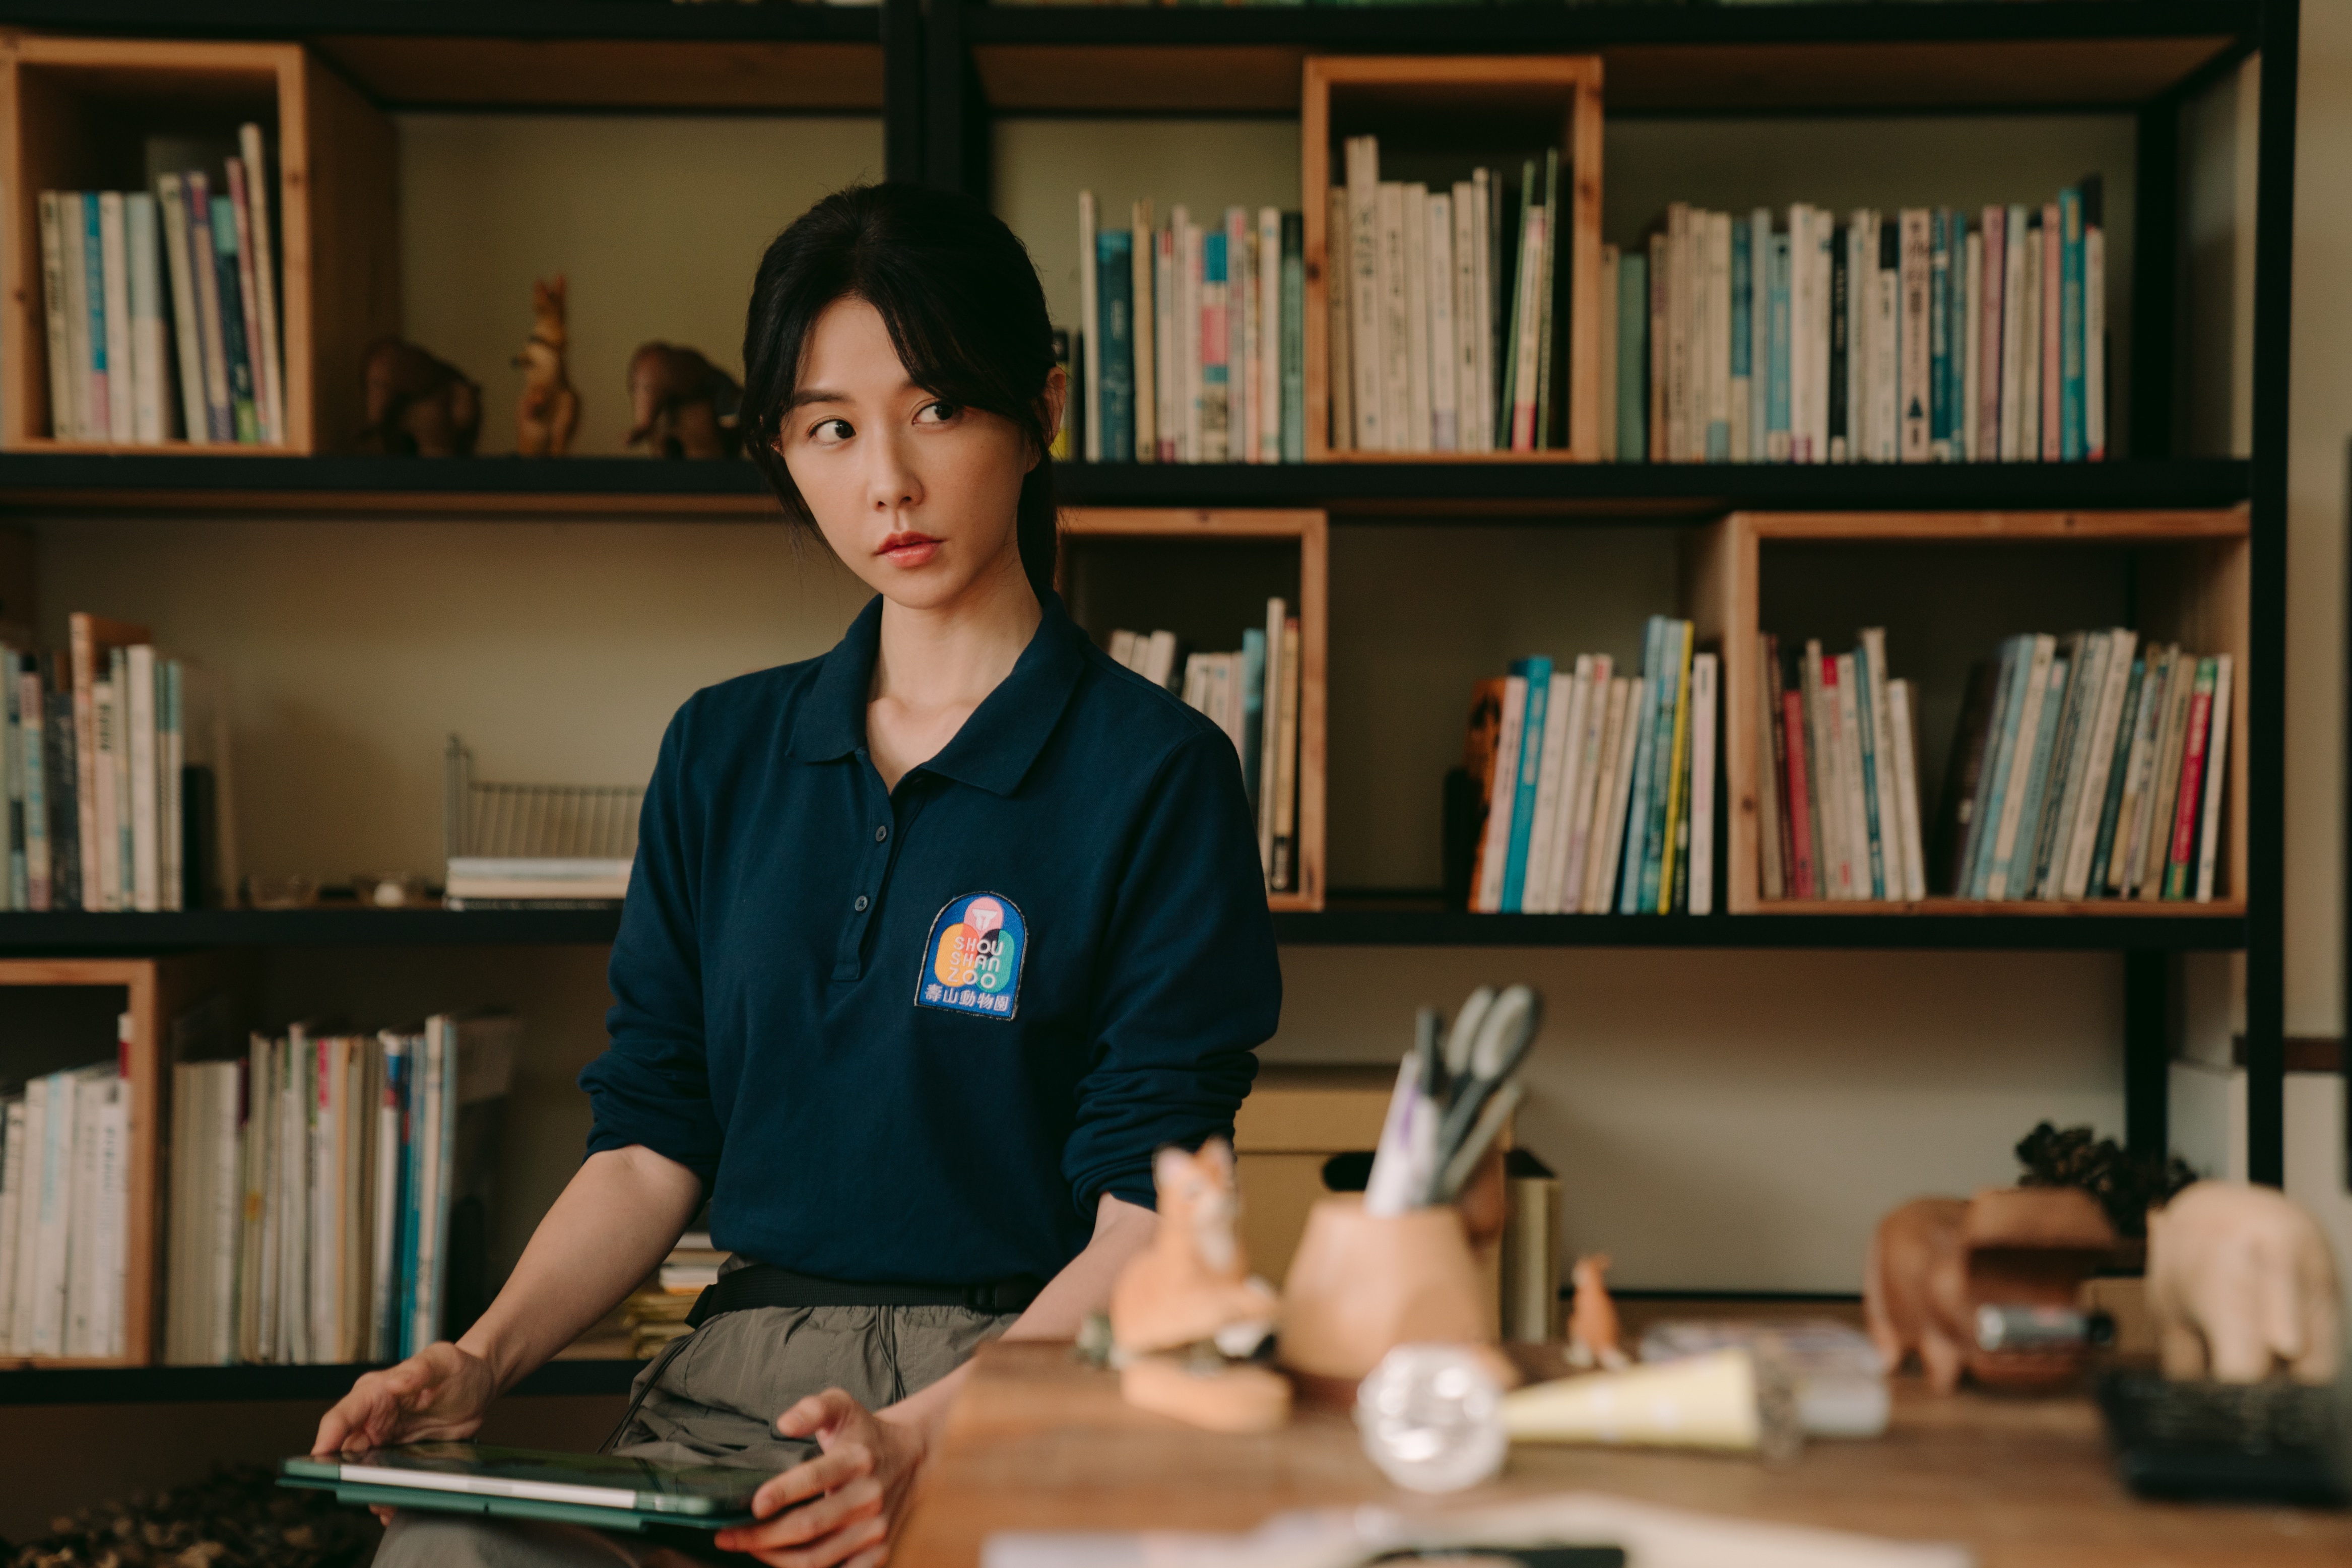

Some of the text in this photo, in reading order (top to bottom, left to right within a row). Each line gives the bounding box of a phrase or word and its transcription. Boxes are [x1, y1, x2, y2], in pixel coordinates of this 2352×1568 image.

[954, 937, 1004, 956] SHOU
[948, 967, 996, 988] ZOO
[925, 984, 1009, 1011] 壽山動物園
